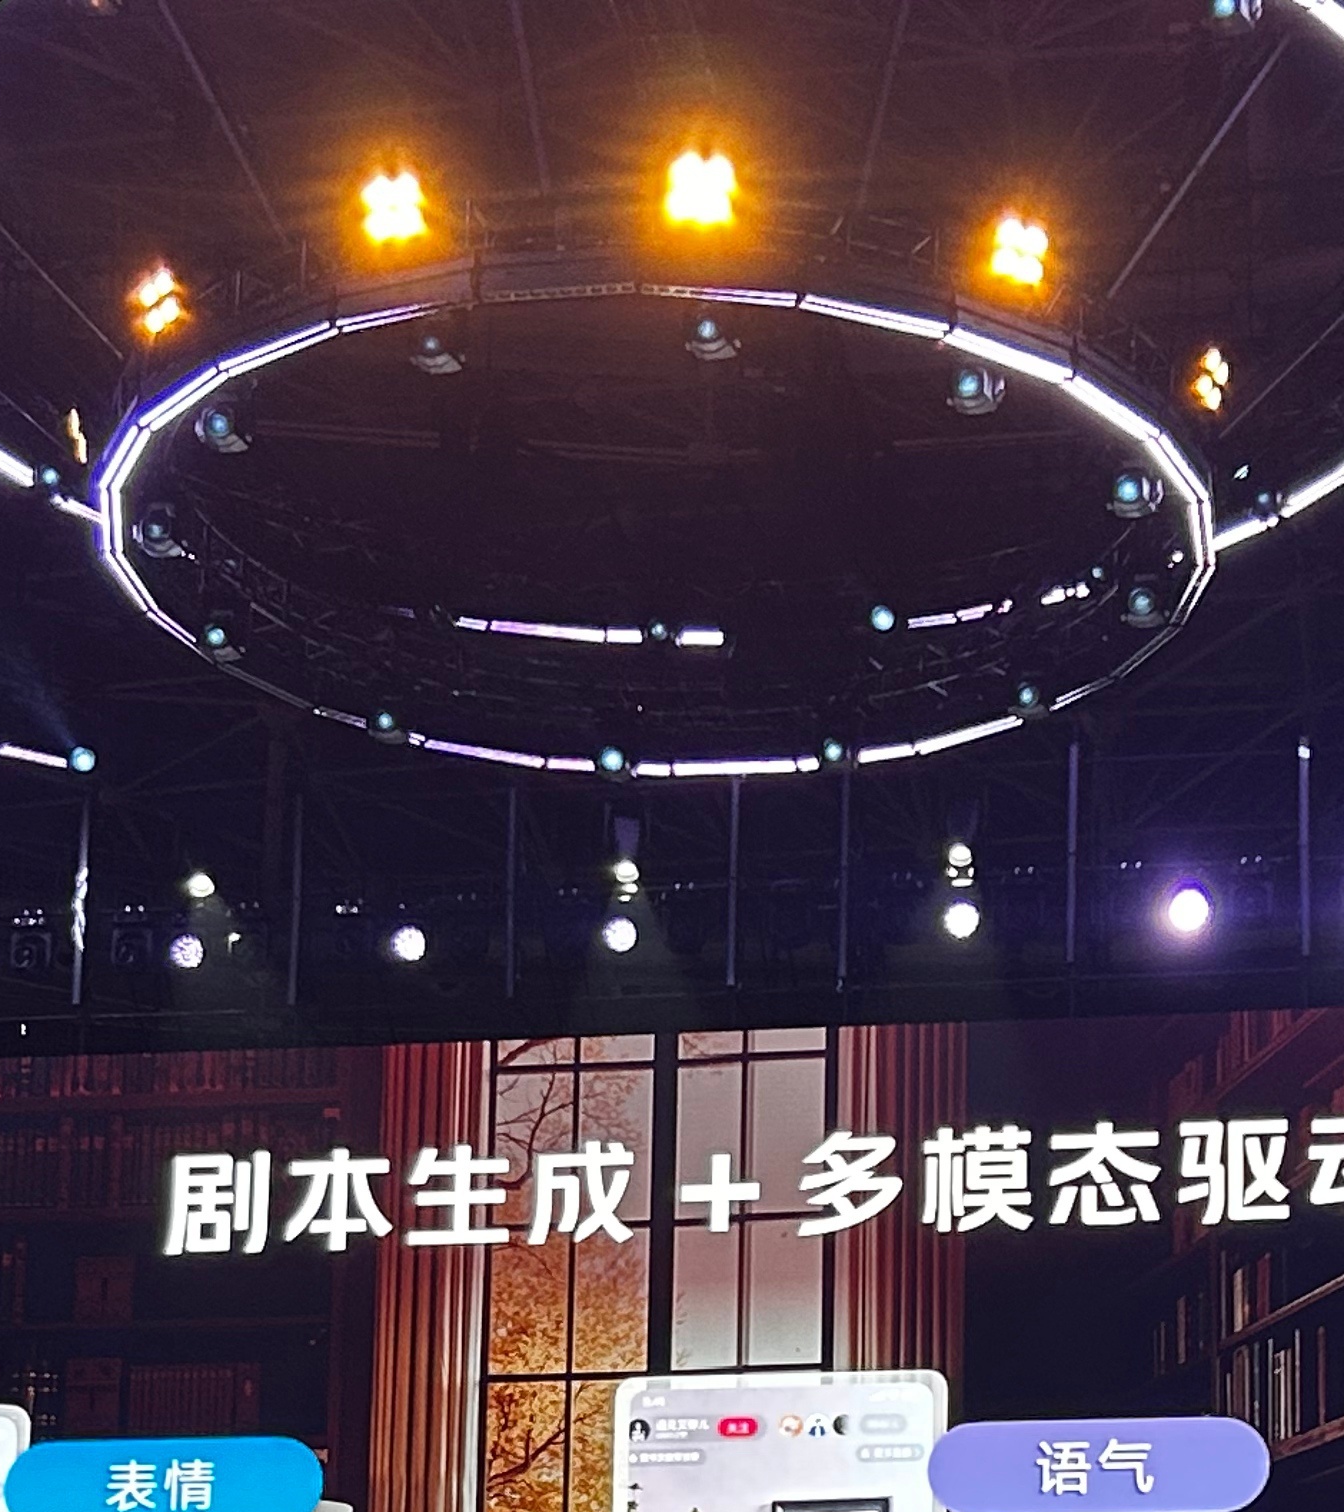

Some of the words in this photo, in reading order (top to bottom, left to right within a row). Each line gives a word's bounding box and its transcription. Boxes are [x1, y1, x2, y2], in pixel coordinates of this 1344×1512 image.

[164, 1139, 635, 1257] 剧本生成
[107, 1459, 215, 1512] 表情
[1035, 1438, 1155, 1496] 语气
